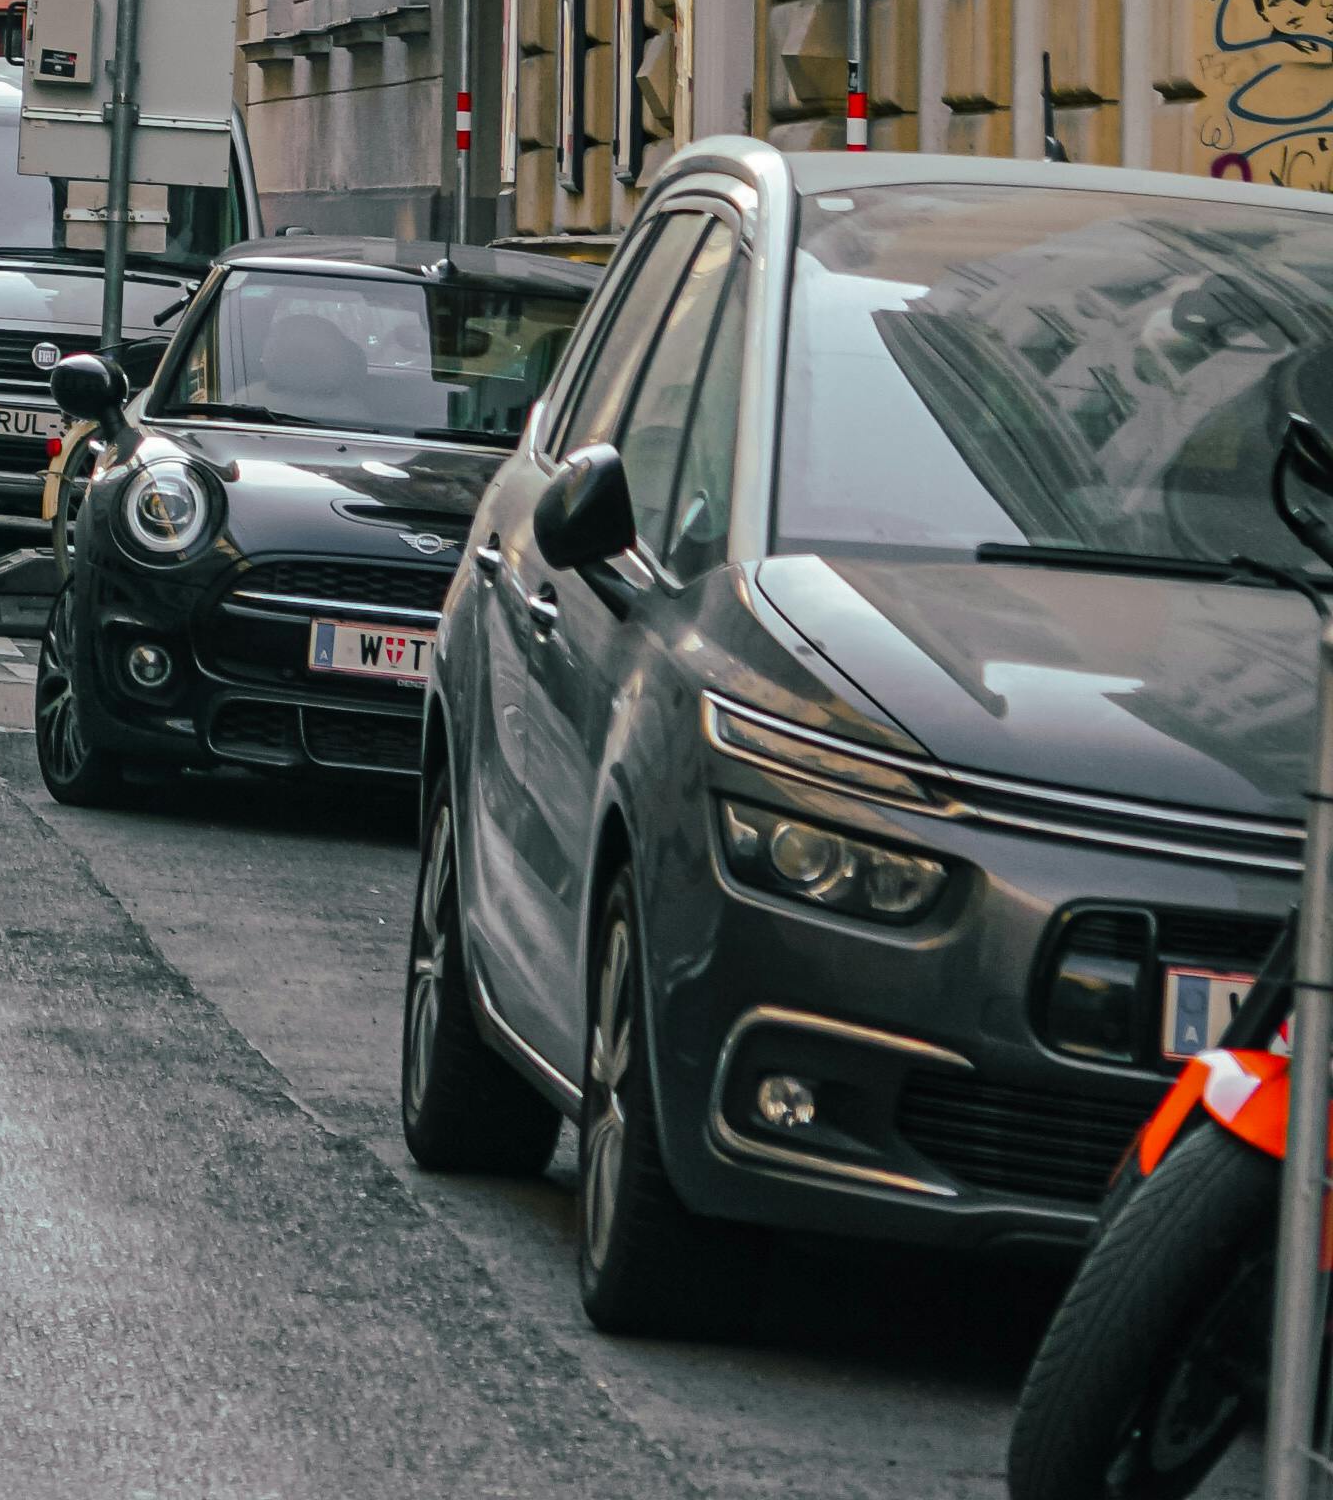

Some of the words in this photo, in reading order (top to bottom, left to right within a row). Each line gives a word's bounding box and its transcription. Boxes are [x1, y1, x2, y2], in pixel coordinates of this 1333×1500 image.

[319, 649, 329, 661] A
[360, 633, 383, 666] W
[410, 639, 435, 671] T
[1184, 1025, 1199, 1043] A
